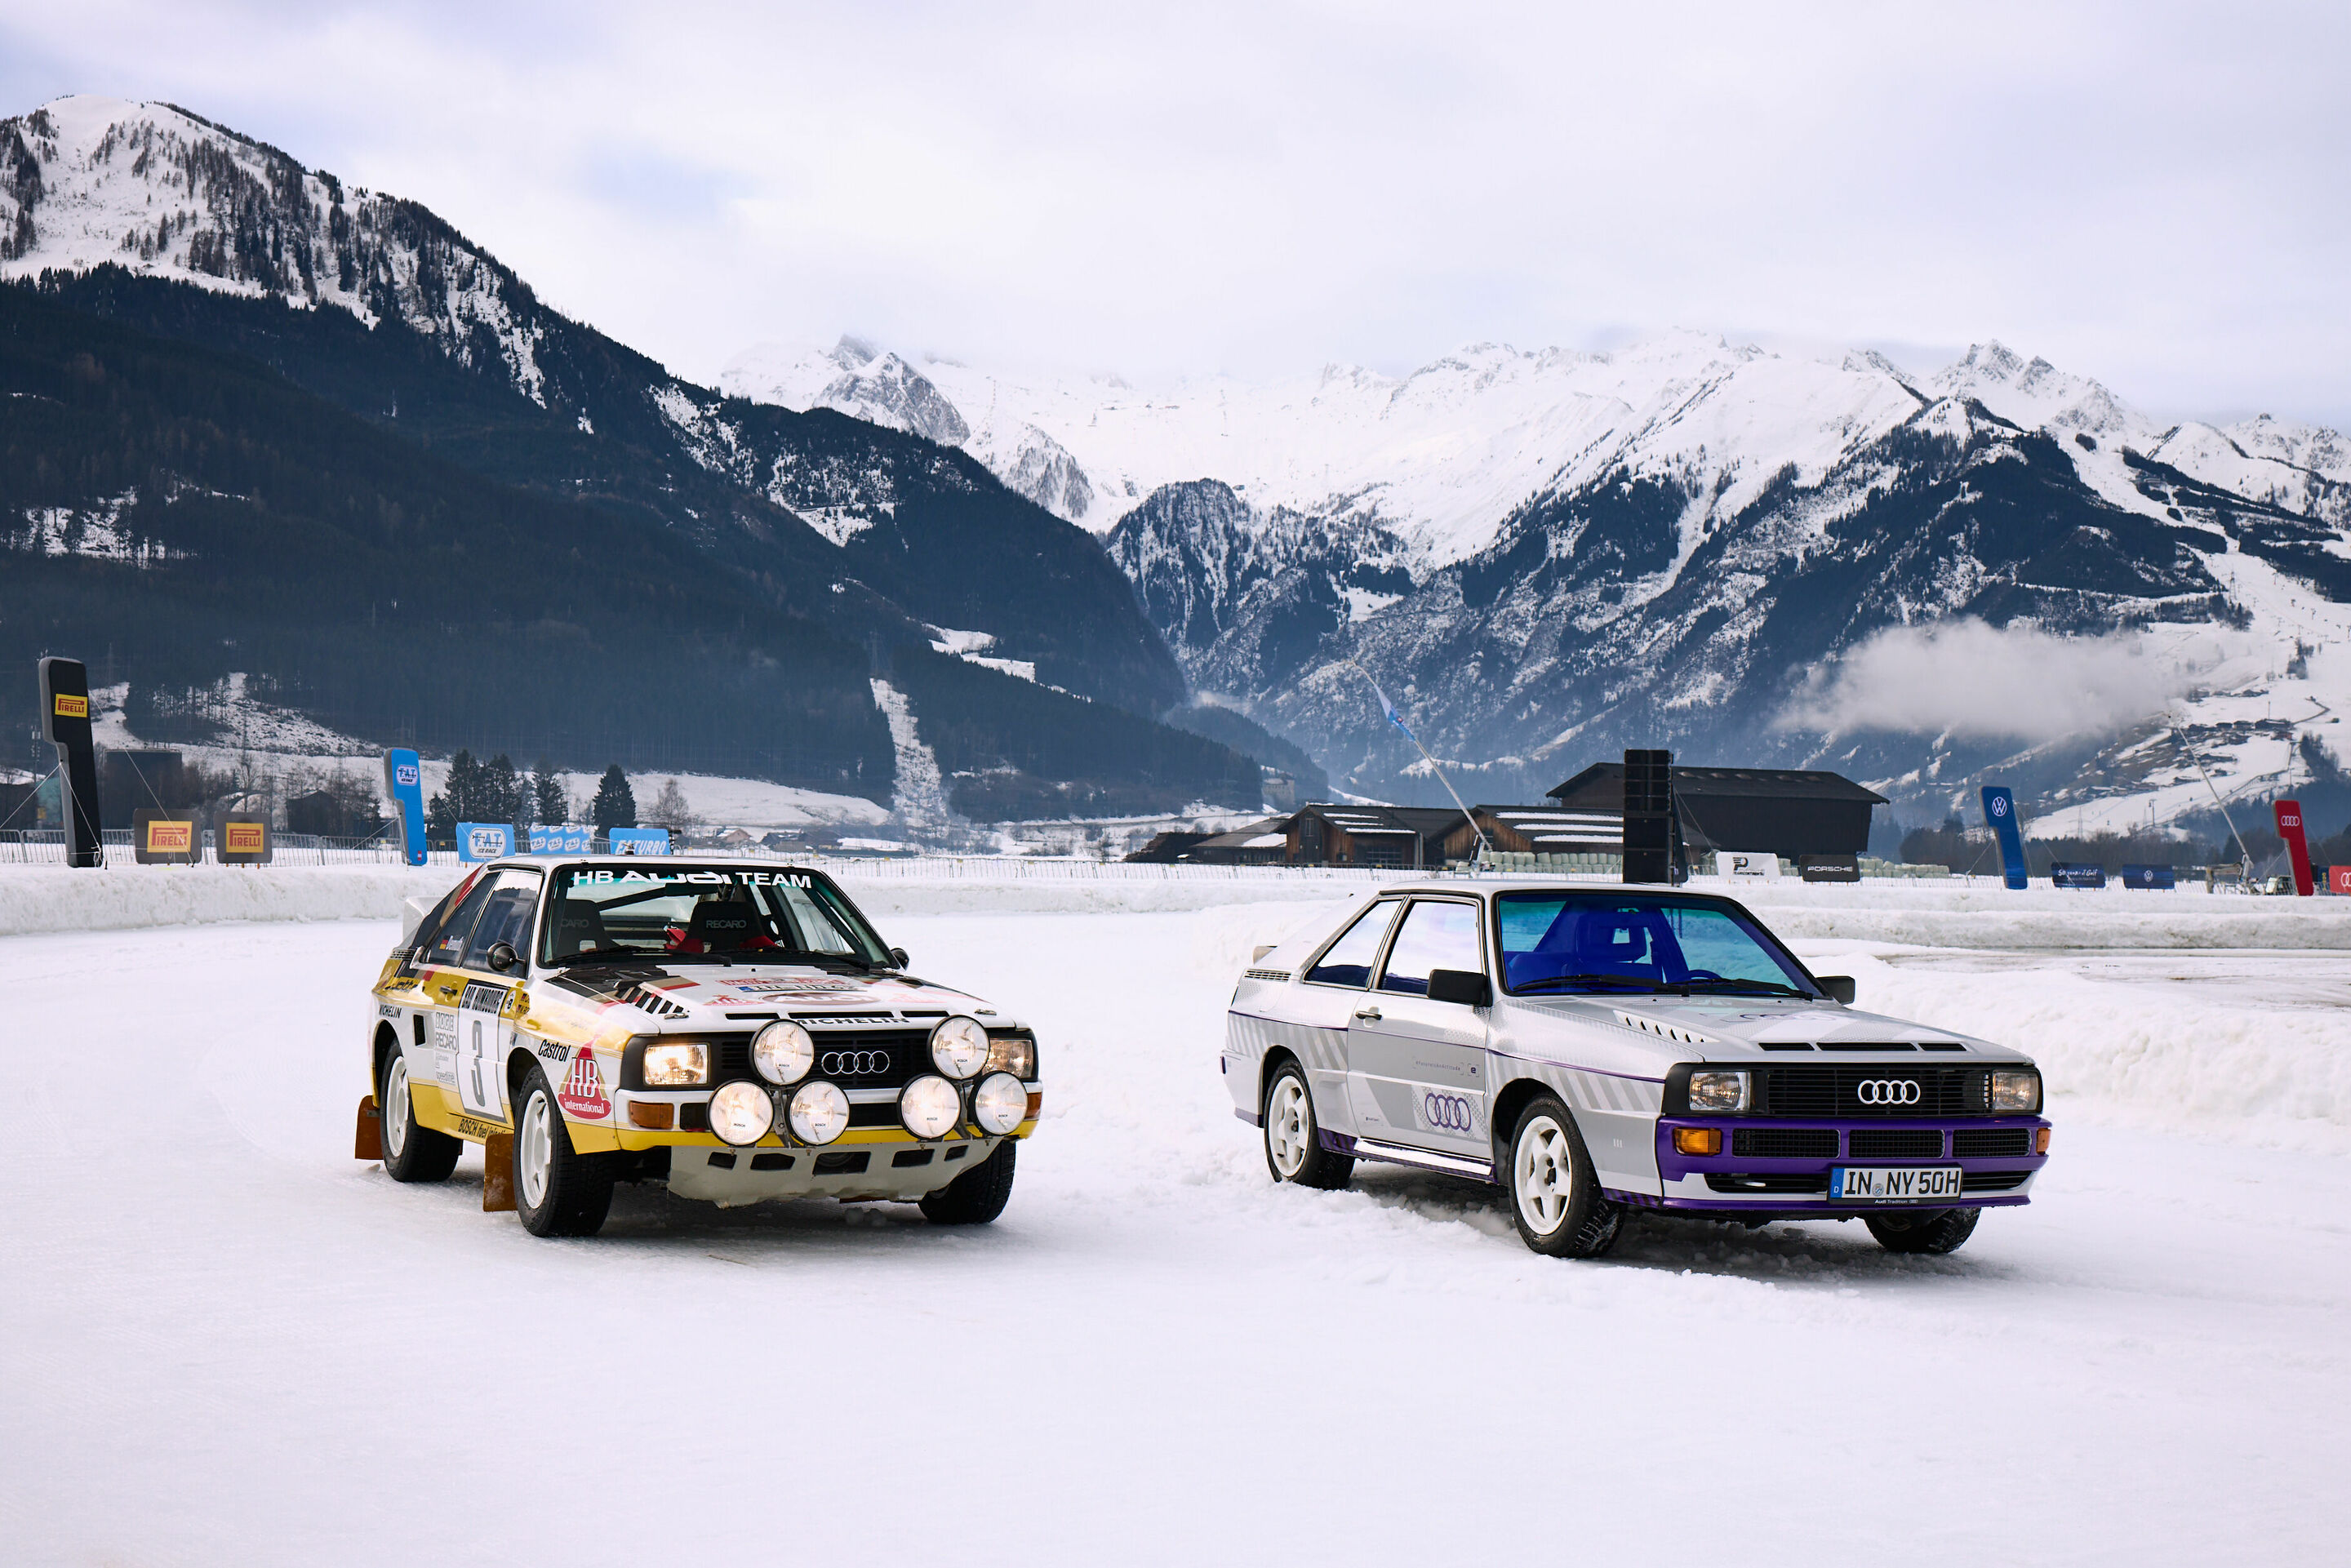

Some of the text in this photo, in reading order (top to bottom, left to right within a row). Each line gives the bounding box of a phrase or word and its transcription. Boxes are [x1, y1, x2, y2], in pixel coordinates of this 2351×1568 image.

[58, 698, 85, 713] PIRELLI
[149, 827, 188, 846] PIRELLI
[229, 828, 260, 846] PIRELLI
[573, 871, 614, 885] HB
[735, 872, 812, 889] TEAM
[706, 920, 747, 929] RECARO
[379, 1005, 402, 1019] MICHELIN
[538, 1039, 571, 1062] Castrol
[472, 1020, 485, 1107] 3
[570, 1057, 599, 1098] HB
[564, 1098, 605, 1114] international
[458, 1118, 479, 1135] BOSCH
[1845, 1171, 1959, 1195] IN NY 50H
